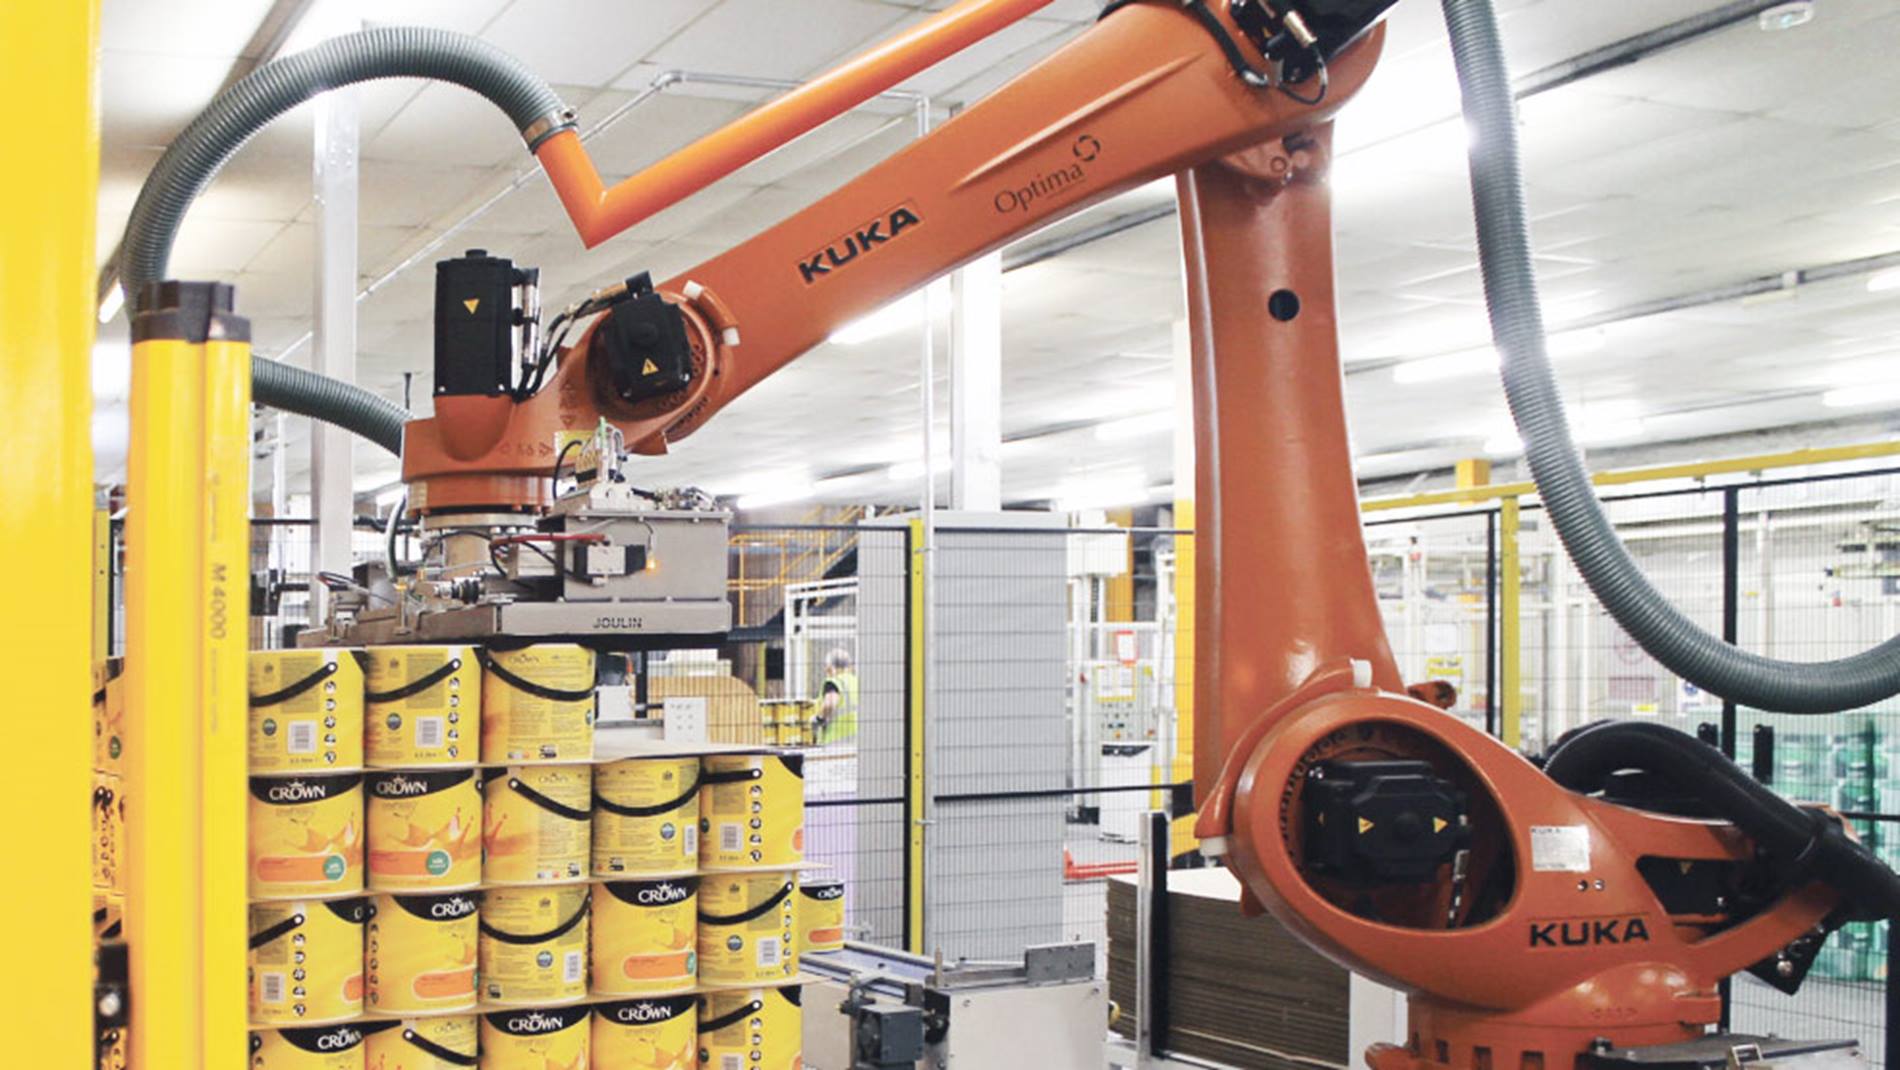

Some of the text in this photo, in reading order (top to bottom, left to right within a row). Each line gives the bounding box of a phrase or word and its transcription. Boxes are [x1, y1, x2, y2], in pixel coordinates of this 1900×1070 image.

[995, 163, 1084, 213] Optima
[799, 208, 919, 283] KUKA
[210, 563, 226, 582] M
[210, 586, 226, 640] 4000
[593, 617, 642, 628] JOULIN
[269, 784, 326, 801] CROWN
[376, 780, 428, 795] CROWN
[638, 886, 687, 904] CROWN
[1530, 919, 1648, 946] KUKA
[618, 1004, 672, 1021] CROWN
[508, 1015, 563, 1032] CROWN
